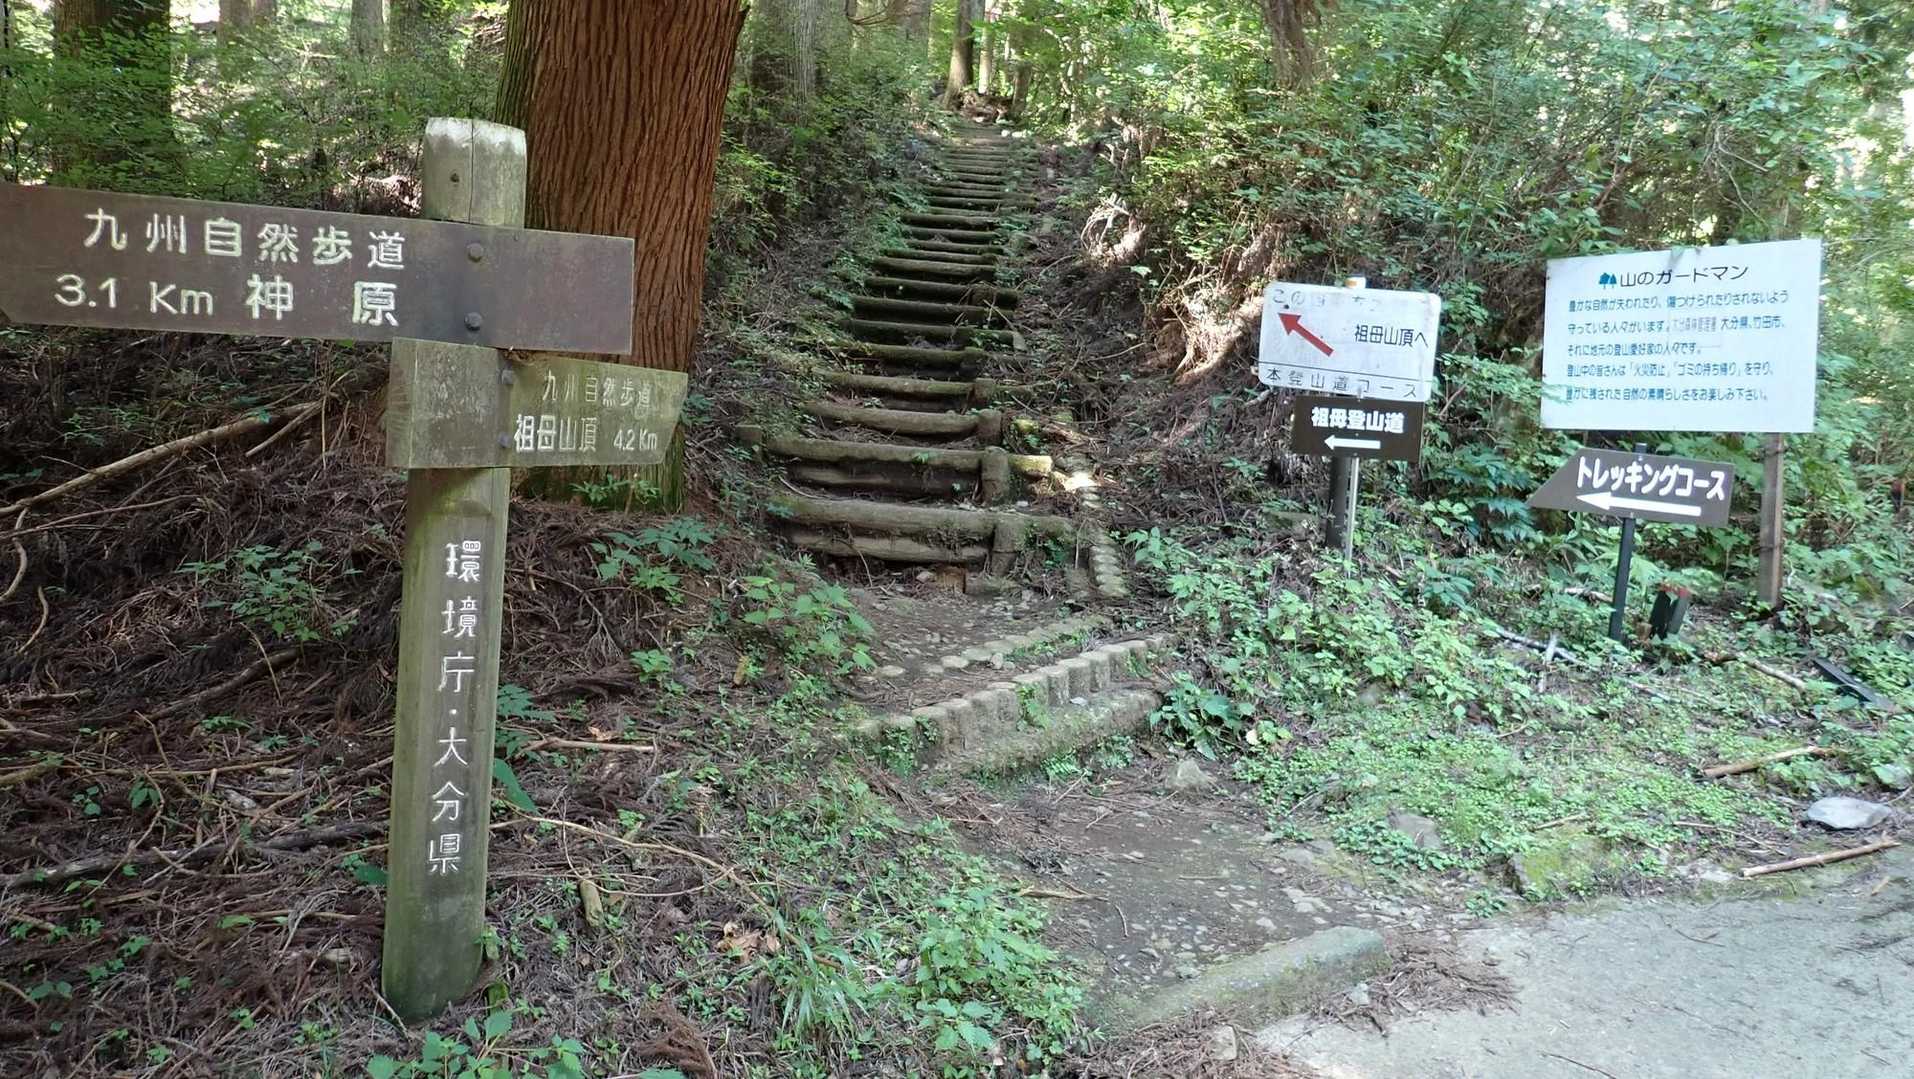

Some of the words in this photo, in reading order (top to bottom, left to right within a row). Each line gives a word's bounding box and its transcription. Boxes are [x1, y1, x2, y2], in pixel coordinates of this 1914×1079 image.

[83, 206, 406, 271] 九州自然歩道
[1619, 266, 1750, 288] 山のガードマン
[54, 273, 119, 310] 3.1
[149, 281, 213, 317] Km
[1354, 323, 1429, 349] 祖母山頂へ
[1265, 367, 1418, 398] 本登山道コース
[514, 413, 598, 453] 祖母山頂
[638, 427, 658, 452] Km
[1311, 406, 1405, 434] 祖母登山道
[1576, 455, 1726, 501] トレッキングコース
